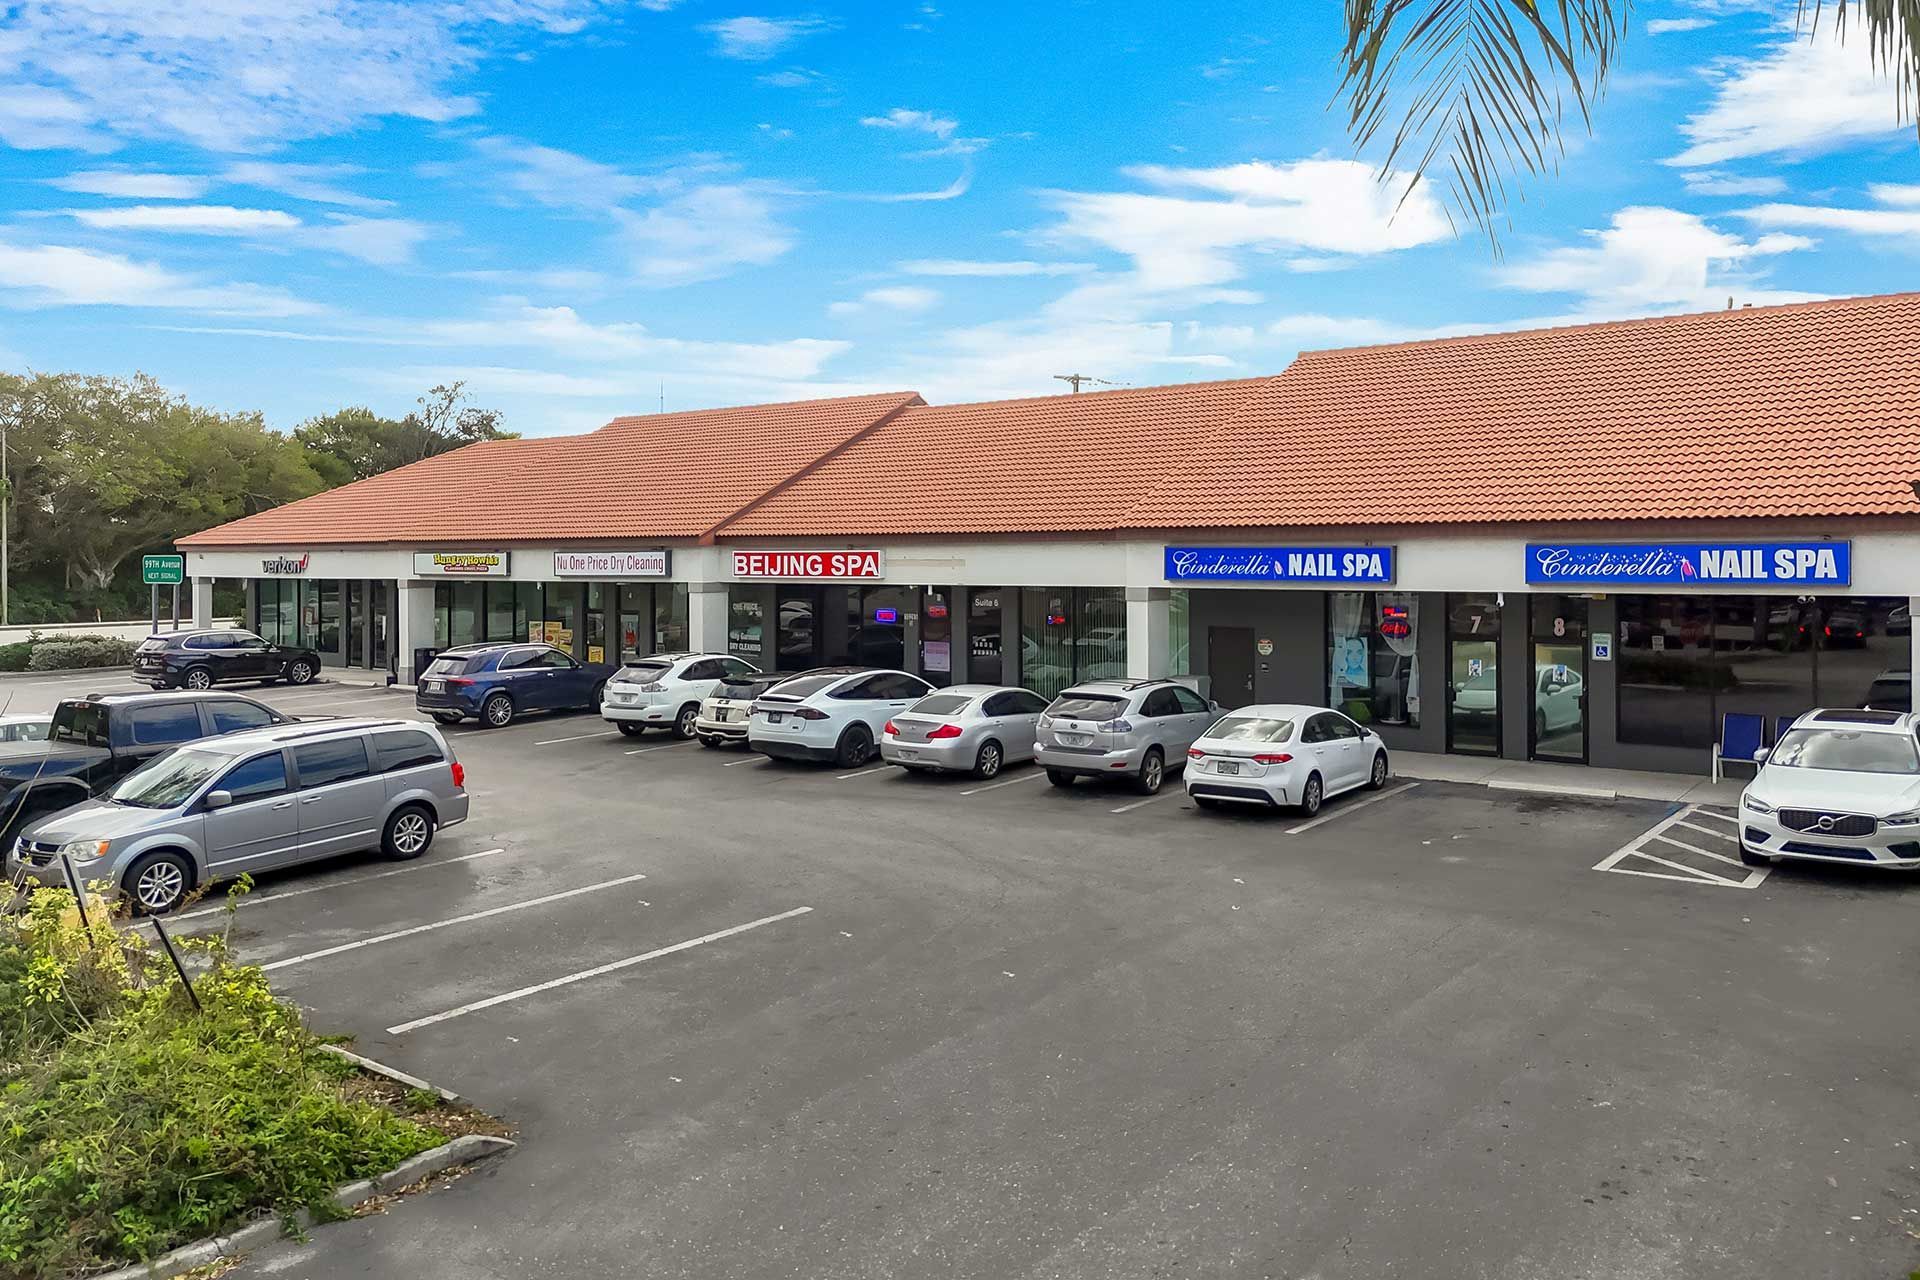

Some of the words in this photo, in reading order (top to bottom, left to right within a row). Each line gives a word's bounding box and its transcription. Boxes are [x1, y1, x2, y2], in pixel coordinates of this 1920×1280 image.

[145, 560, 160, 568] 99TH
[262, 555, 302, 574] verizon
[433, 552, 466, 566] Hungry
[467, 553, 499, 566] Howie's
[557, 556, 568, 570] Nu
[569, 555, 585, 570] One
[587, 555, 608, 570] Price
[610, 556, 625, 573] Dry
[627, 555, 664, 573] Cleaning
[734, 555, 823, 576] BEIJING
[831, 555, 878, 576] SPA
[1173, 551, 1269, 577] Cinderella
[1288, 553, 1337, 577] NAIL
[1342, 553, 1383, 577] SPA
[1536, 548, 1675, 578] Cinderella
[1700, 550, 1768, 579] NAIL
[1774, 549, 1838, 579] SPA
[975, 598, 993, 607] Suite
[1381, 622, 1408, 634] OPEN
[1470, 615, 1482, 634] 7
[1553, 617, 1566, 637] 8
